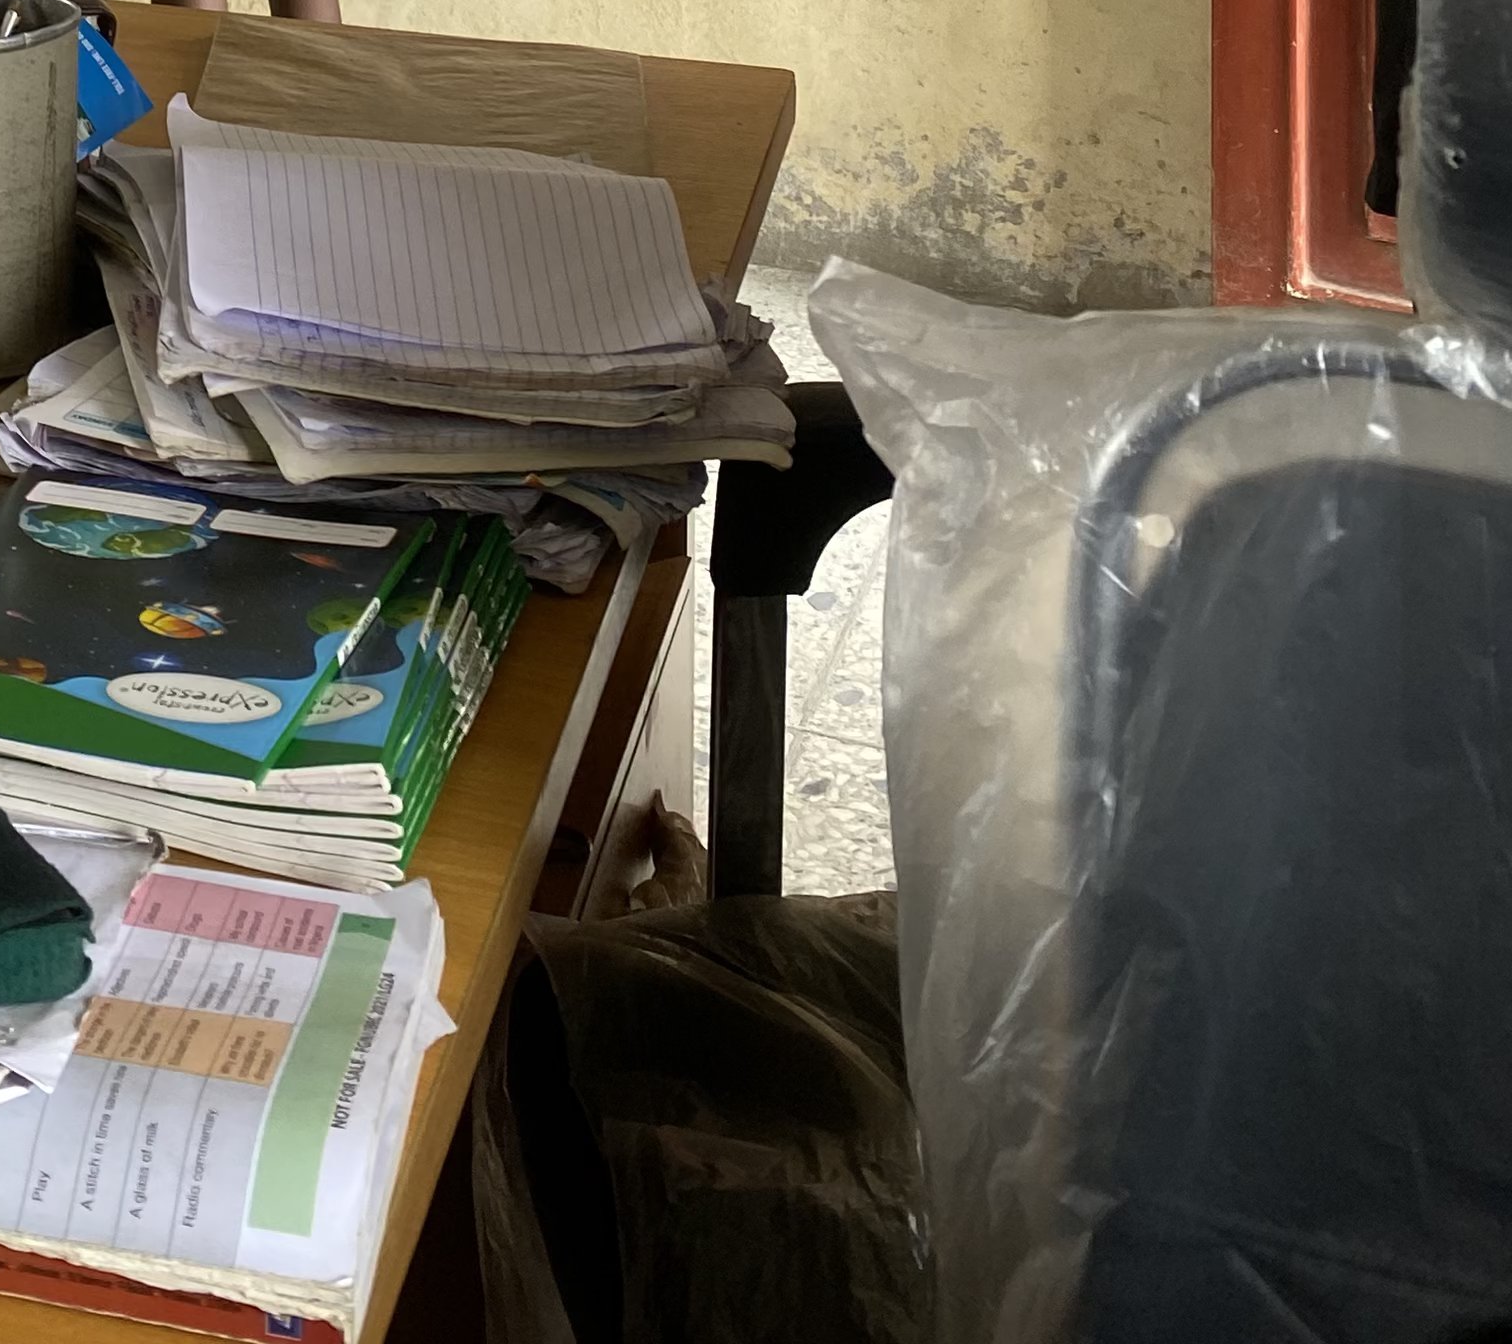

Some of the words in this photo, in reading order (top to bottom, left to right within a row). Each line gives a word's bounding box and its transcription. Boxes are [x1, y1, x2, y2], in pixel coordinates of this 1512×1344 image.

[312, 690, 371, 709] eXp
[345, 1059, 366, 1082] SALE
[339, 1082, 357, 1103] FOR
[96, 1112, 111, 1142] time
[331, 1105, 351, 1129] NOT
[145, 1121, 159, 1146] milk
[94, 1141, 103, 1157] in
[143, 1146, 152, 1164] of
[85, 1155, 100, 1194] stitch
[182, 1179, 201, 1227] Radio
[193, 1107, 218, 1181] commentary
[32, 1169, 50, 1202] Play
[137, 1164, 150, 1205] glass
[80, 1199, 93, 1211] A
[128, 1206, 143, 1219] A
